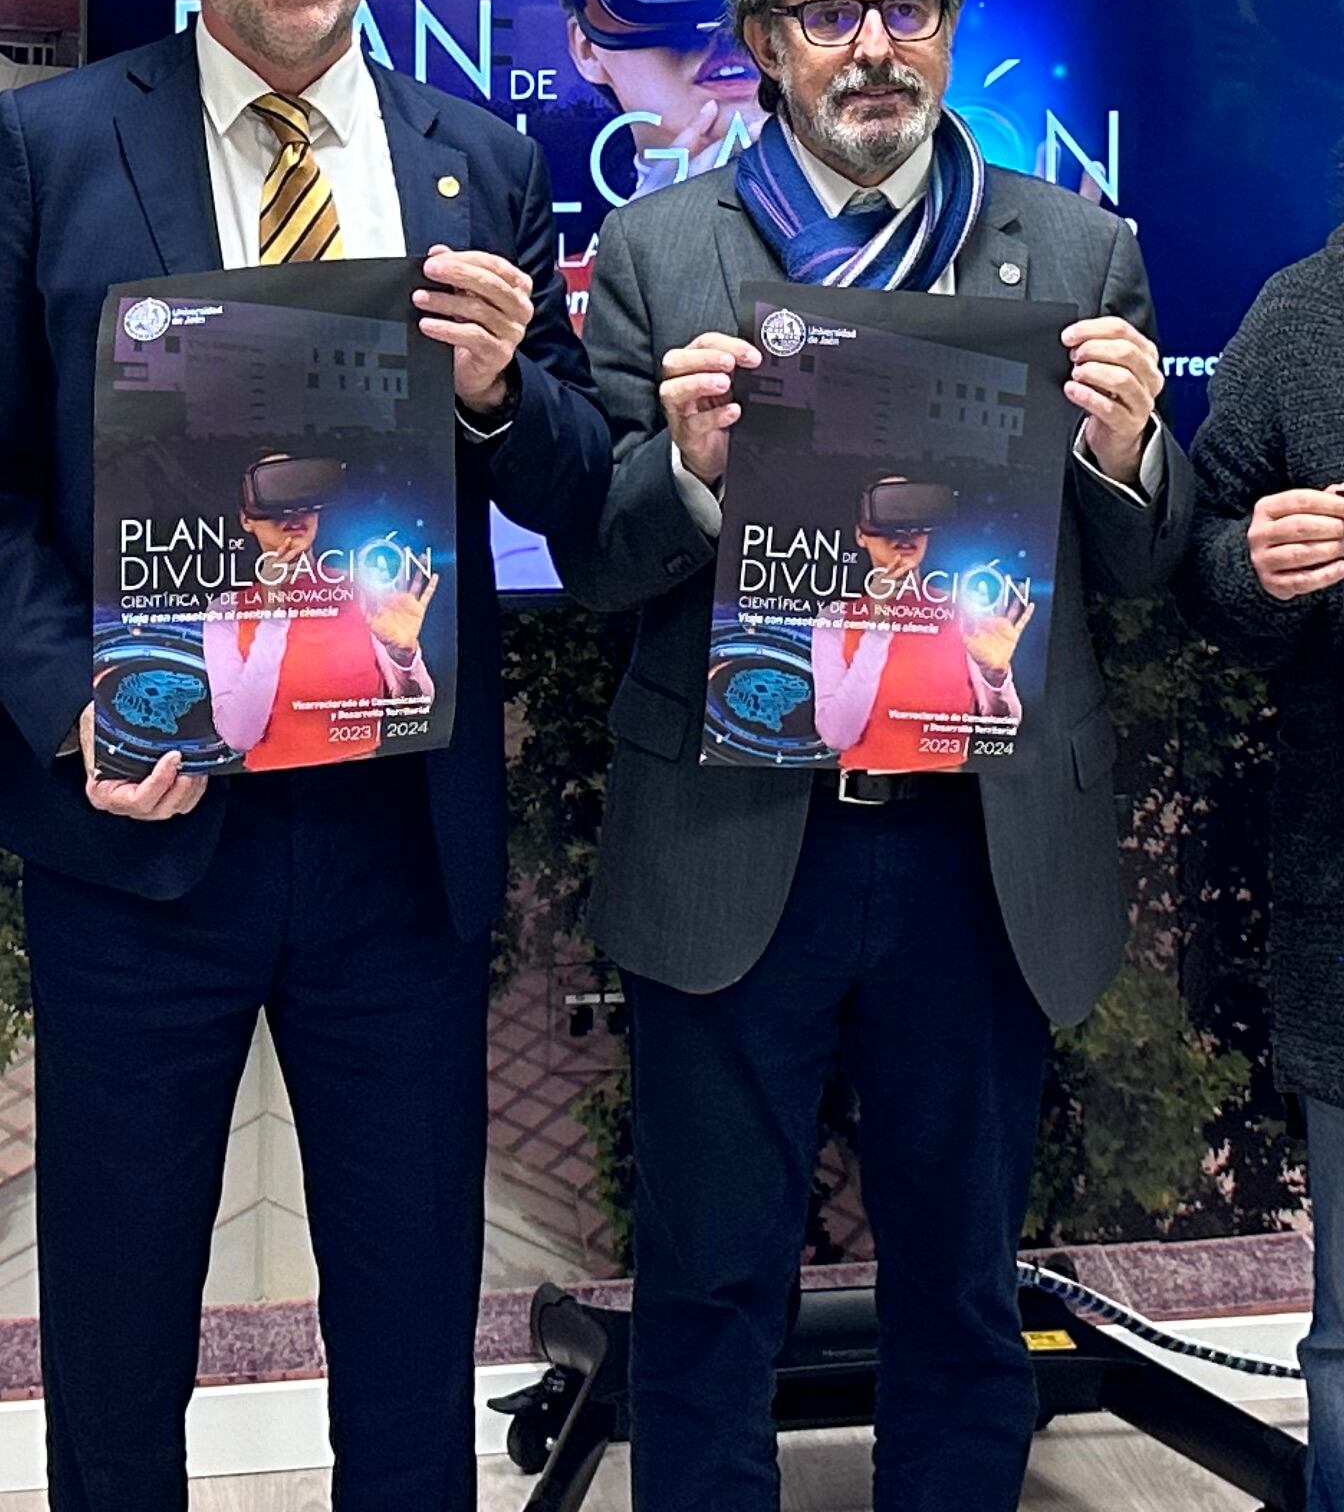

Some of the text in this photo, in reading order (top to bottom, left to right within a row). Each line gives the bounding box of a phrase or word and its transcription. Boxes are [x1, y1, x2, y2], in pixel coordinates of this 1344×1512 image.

[509, 69, 558, 101] DE
[122, 517, 244, 552] PLAN DE
[743, 525, 857, 563] PLAN DE
[121, 531, 432, 590] DIVULGACIÓN
[121, 587, 353, 607] CIENTÍFICA Y DE LA INNOVACIÓN
[739, 559, 1030, 607] DIVULGACIÓN
[739, 596, 954, 620] CIENTÍFICA Y DE LA INNOVACIÓN
[328, 721, 428, 742] 2023 2024
[919, 738, 1014, 755] 2023 2024
